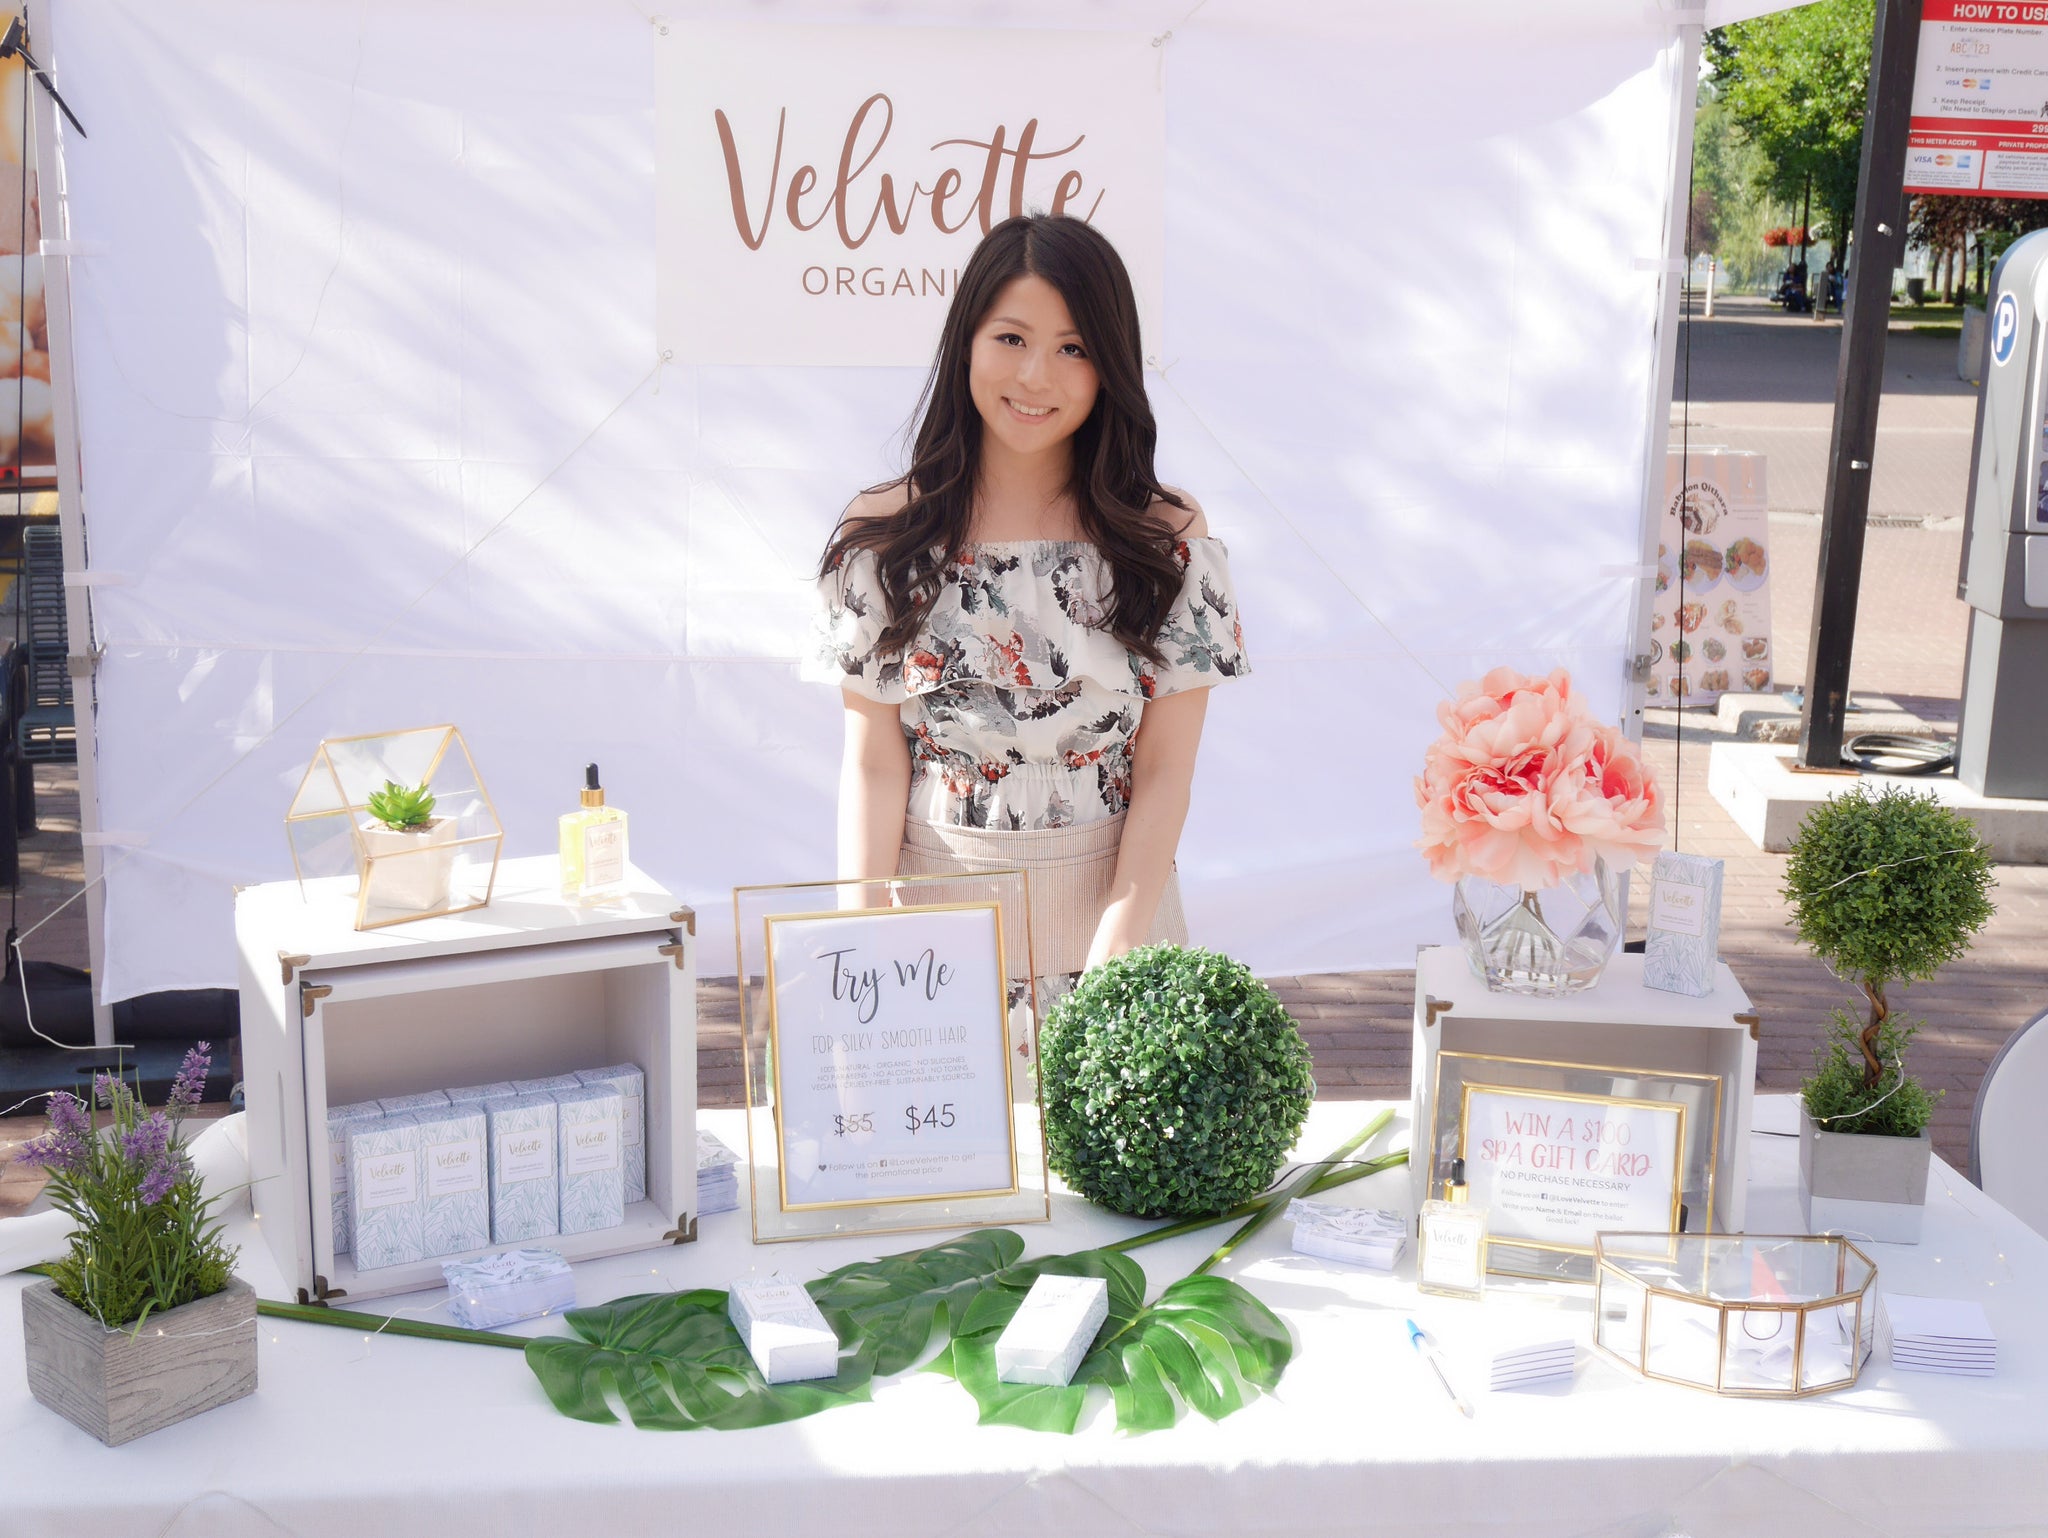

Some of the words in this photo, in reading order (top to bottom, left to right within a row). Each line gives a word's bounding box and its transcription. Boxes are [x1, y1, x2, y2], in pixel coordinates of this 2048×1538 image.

[1953, 3, 1993, 19] HOW
[1996, 5, 2018, 20] TO
[1950, 25, 1968, 33] Enter
[1969, 26, 1995, 34] Licence
[1997, 27, 2014, 35] Plate
[1950, 42, 1968, 54] ABC
[1974, 43, 1991, 55] 123
[1966, 67, 1995, 75] payment
[1996, 67, 2010, 75] with
[2011, 68, 2032, 76] Credit
[1941, 97, 1959, 105] Keep
[1981, 107, 2006, 115] Display
[1910, 137, 1925, 145] THIS
[1926, 138, 1947, 146] METER
[1948, 139, 1977, 147] ACCEPTS
[1998, 141, 2024, 149] PRIVATE
[714, 92, 1106, 251] Velvette
[1997, 303, 2013, 353] P
[1662, 889, 1696, 907] Velvette
[816, 948, 886, 1024] Try
[893, 948, 956, 1001] Me
[811, 1034, 834, 1055] FOR
[841, 1032, 874, 1053] SILKY
[881, 1027, 933, 1050] SMOOTH
[938, 1025, 968, 1045] HAIR
[840, 1063, 871, 1072] NATURAL
[876, 1060, 911, 1069] ORGANIC
[916, 1058, 929, 1066] NO
[930, 1055, 966, 1065] SILICONES
[811, 1082, 838, 1091] VEGAN
[843, 1079, 892, 1089] CRUELTY-FREE
[896, 1076, 940, 1085] SUSTAINABLY
[941, 1072, 976, 1082] SOURCED
[817, 1074, 829, 1082] NO
[873, 1070, 885, 1078] NO
[886, 1067, 925, 1077] ALCOHOLS
[930, 1066, 942, 1074] NO
[944, 1064, 969, 1073] TOXINS
[833, 1112, 876, 1138] $55
[905, 1103, 956, 1135] $45
[1505, 1111, 1551, 1138] WIN
[1556, 1117, 1575, 1141] A
[1581, 1119, 1631, 1146] $100
[508, 1139, 544, 1155] Velvette
[575, 1131, 608, 1146] Velvette
[436, 1151, 471, 1167] Velvette
[829, 1162, 854, 1172] Follow
[857, 1162, 866, 1170] us
[867, 1160, 879, 1169] on
[889, 1155, 950, 1168] @LoveVelvette
[951, 1154, 960, 1162] to
[961, 1153, 976, 1163] get
[1480, 1138, 1523, 1165] SPA
[1531, 1143, 1577, 1170] GIFT
[1585, 1148, 1653, 1177] CARD
[370, 1162, 407, 1179] Velvette
[855, 1171, 869, 1180] the
[871, 1167, 921, 1180] promotional
[922, 1166, 943, 1177] price
[1500, 1170, 1516, 1180] NO
[1517, 1171, 1570, 1186] PURCHASE
[1572, 1178, 1631, 1192] NECESSARY
[1549, 1194, 1601, 1206] @LoveVelvette
[1601, 1199, 1609, 1207] to
[1502, 1202, 1519, 1210] Write
[1563, 1208, 1582, 1217] Email
[1545, 1216, 1564, 1224] Good
